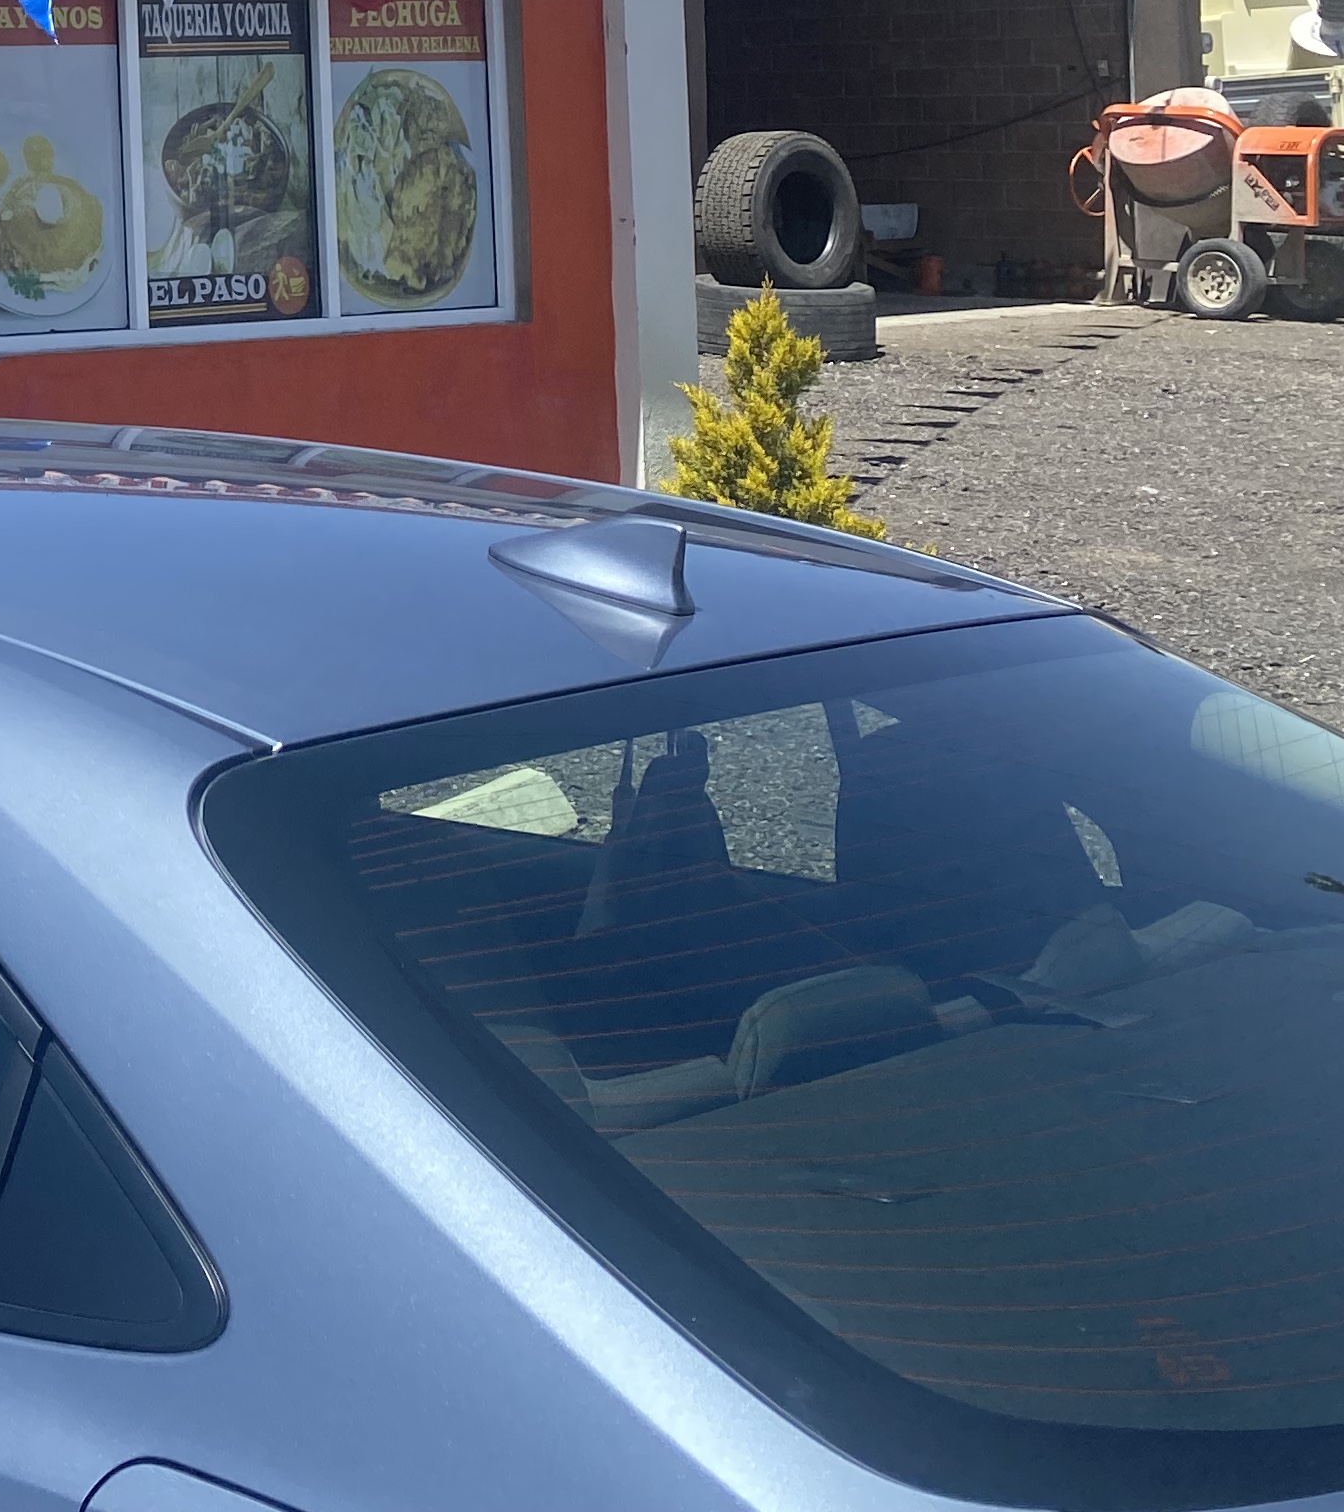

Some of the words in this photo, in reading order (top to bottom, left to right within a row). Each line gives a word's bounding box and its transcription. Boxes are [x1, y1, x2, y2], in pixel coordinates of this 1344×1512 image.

[141, 3, 223, 44] TAQUERIA
[223, 3, 234, 36] Y
[235, 2, 292, 37] COCINA
[411, 37, 422, 54] Y
[422, 35, 481, 54] RELLENA
[149, 279, 190, 307] EL
[192, 273, 267, 304] PASO
